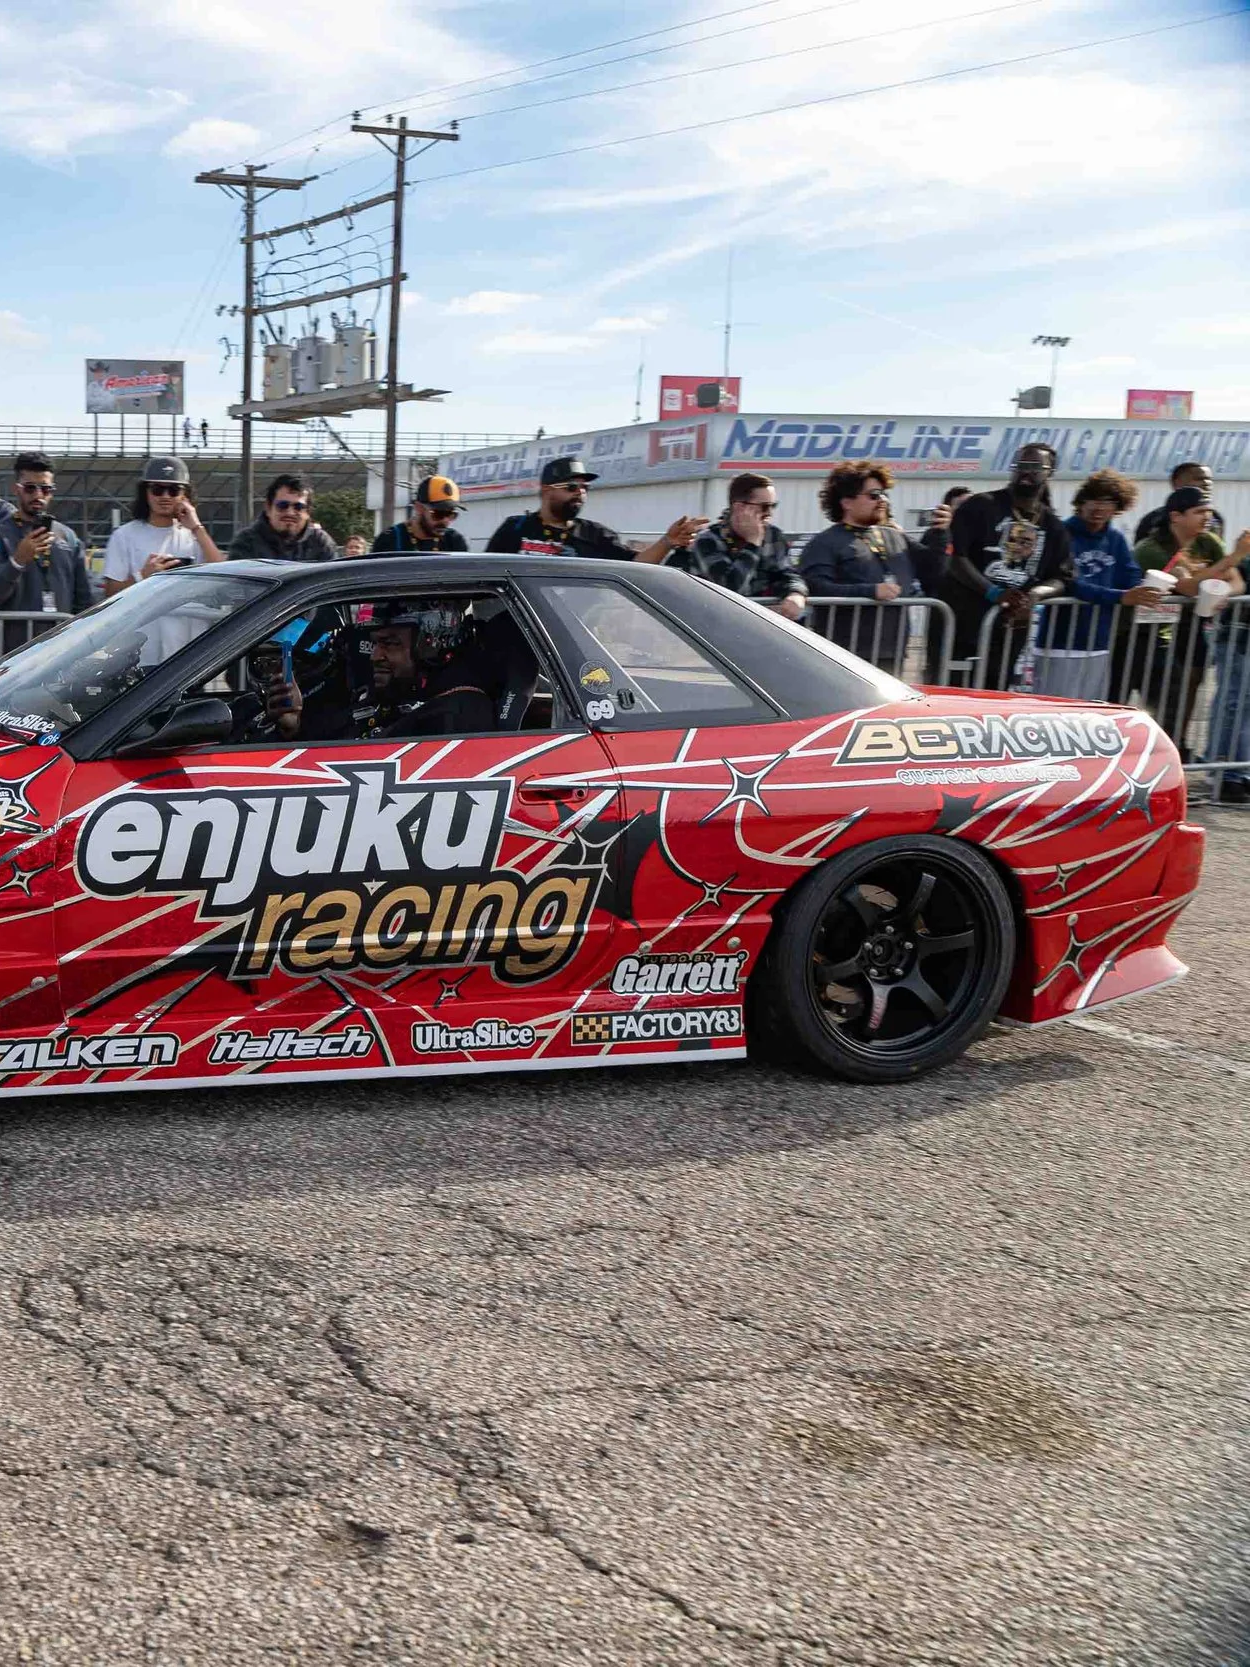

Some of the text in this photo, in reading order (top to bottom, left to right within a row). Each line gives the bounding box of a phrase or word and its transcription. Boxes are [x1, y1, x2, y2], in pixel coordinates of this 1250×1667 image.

[722, 419, 992, 459] MODULINE
[586, 699, 615, 720] 69
[84, 770, 499, 905] enjuku
[249, 877, 592, 977] racing
[612, 957, 740, 993] Garrett
[643, 953, 711, 963] TURBO BY
[415, 1021, 533, 1050] UltraSlice
[612, 1010, 740, 1039] FACTORY83
[216, 1027, 374, 1061] Haltech
